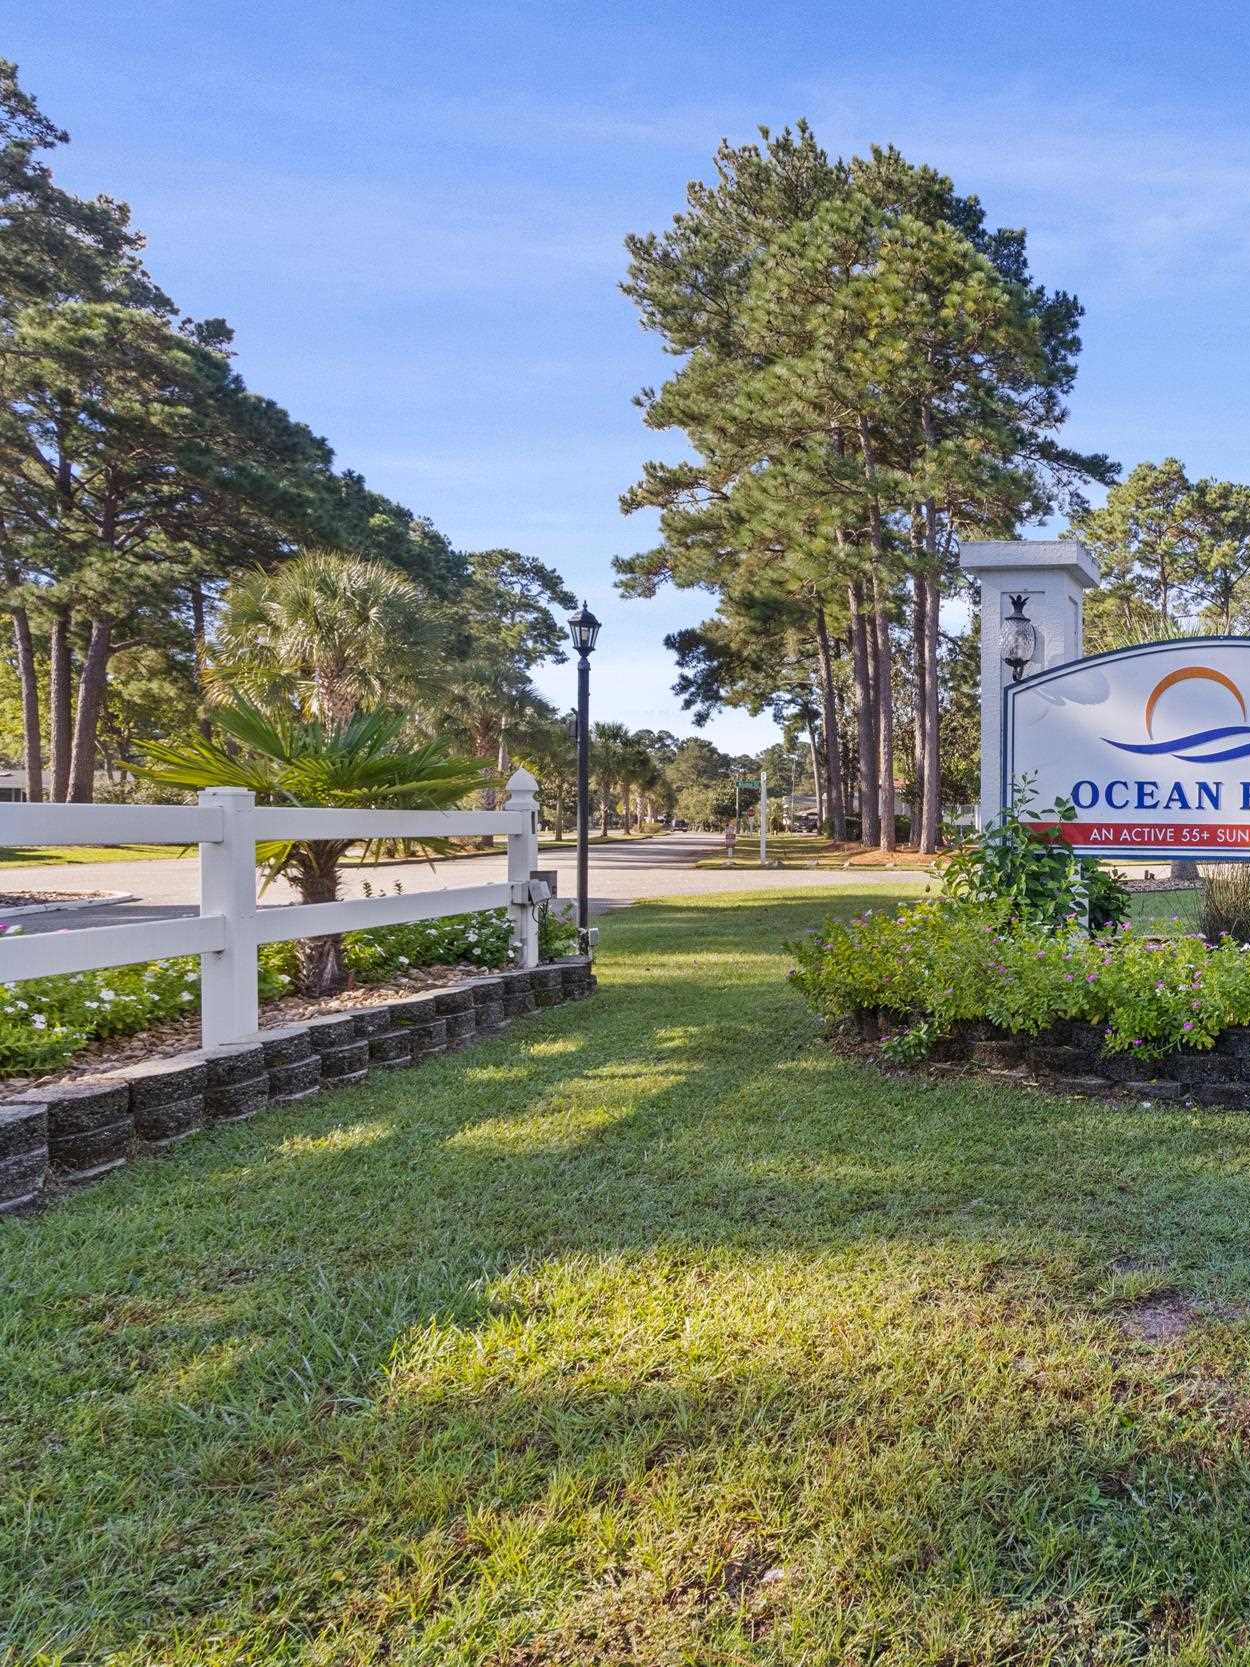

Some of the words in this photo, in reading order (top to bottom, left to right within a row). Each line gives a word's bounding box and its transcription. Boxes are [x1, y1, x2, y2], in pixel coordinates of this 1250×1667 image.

[1071, 780, 1224, 810] OCEAN
[1089, 828, 1113, 841] AN
[1120, 828, 1174, 842] ACTIVE
[1181, 828, 1210, 842] 55+
[1216, 829, 1249, 842] SUN
